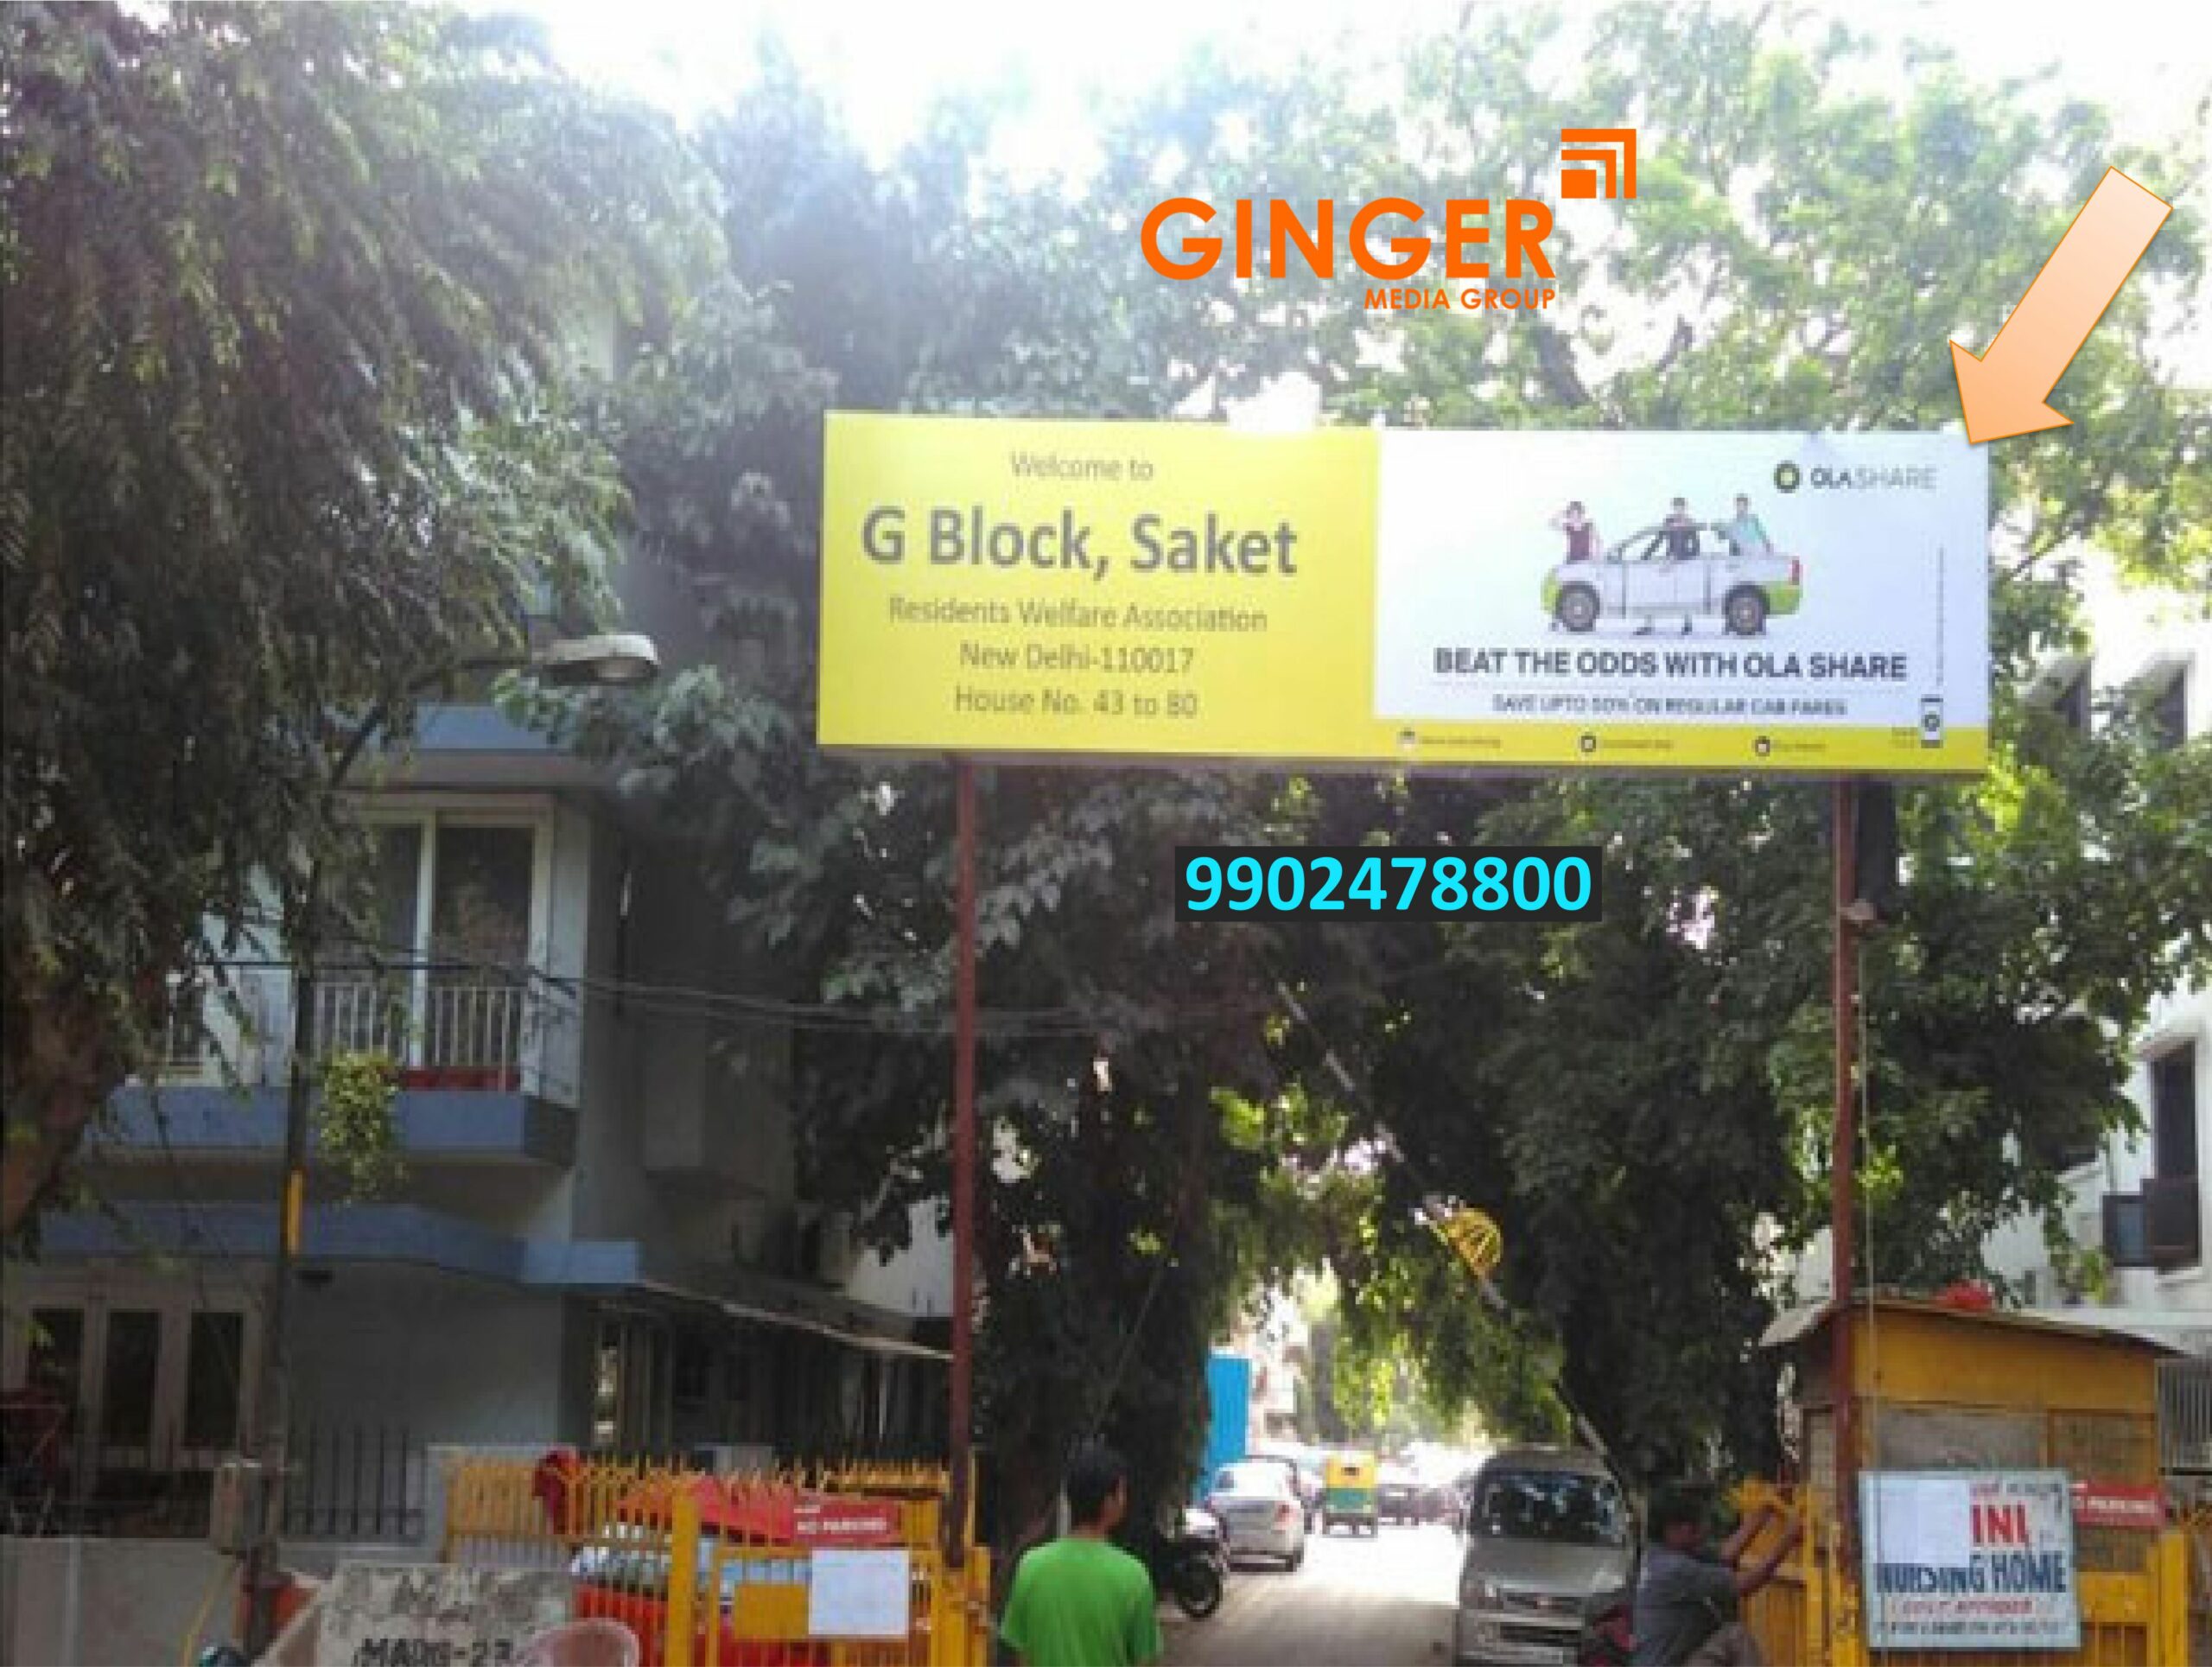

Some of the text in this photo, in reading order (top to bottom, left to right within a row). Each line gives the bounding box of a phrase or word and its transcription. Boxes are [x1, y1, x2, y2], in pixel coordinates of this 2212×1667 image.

[1010, 451, 1154, 480] Welcome to
[862, 505, 1298, 581] G Block, Saket
[889, 596, 1268, 633] Residents Welfare Association
[960, 643, 1193, 674] New Delhi-110017
[1433, 648, 1907, 680] BEAT THE ODDS WITH OLA SHARE
[955, 688, 1198, 717] House No. 43 to 80
[1493, 693, 1536, 711] SAVE
[1992, 1552, 2066, 1593] HOME
